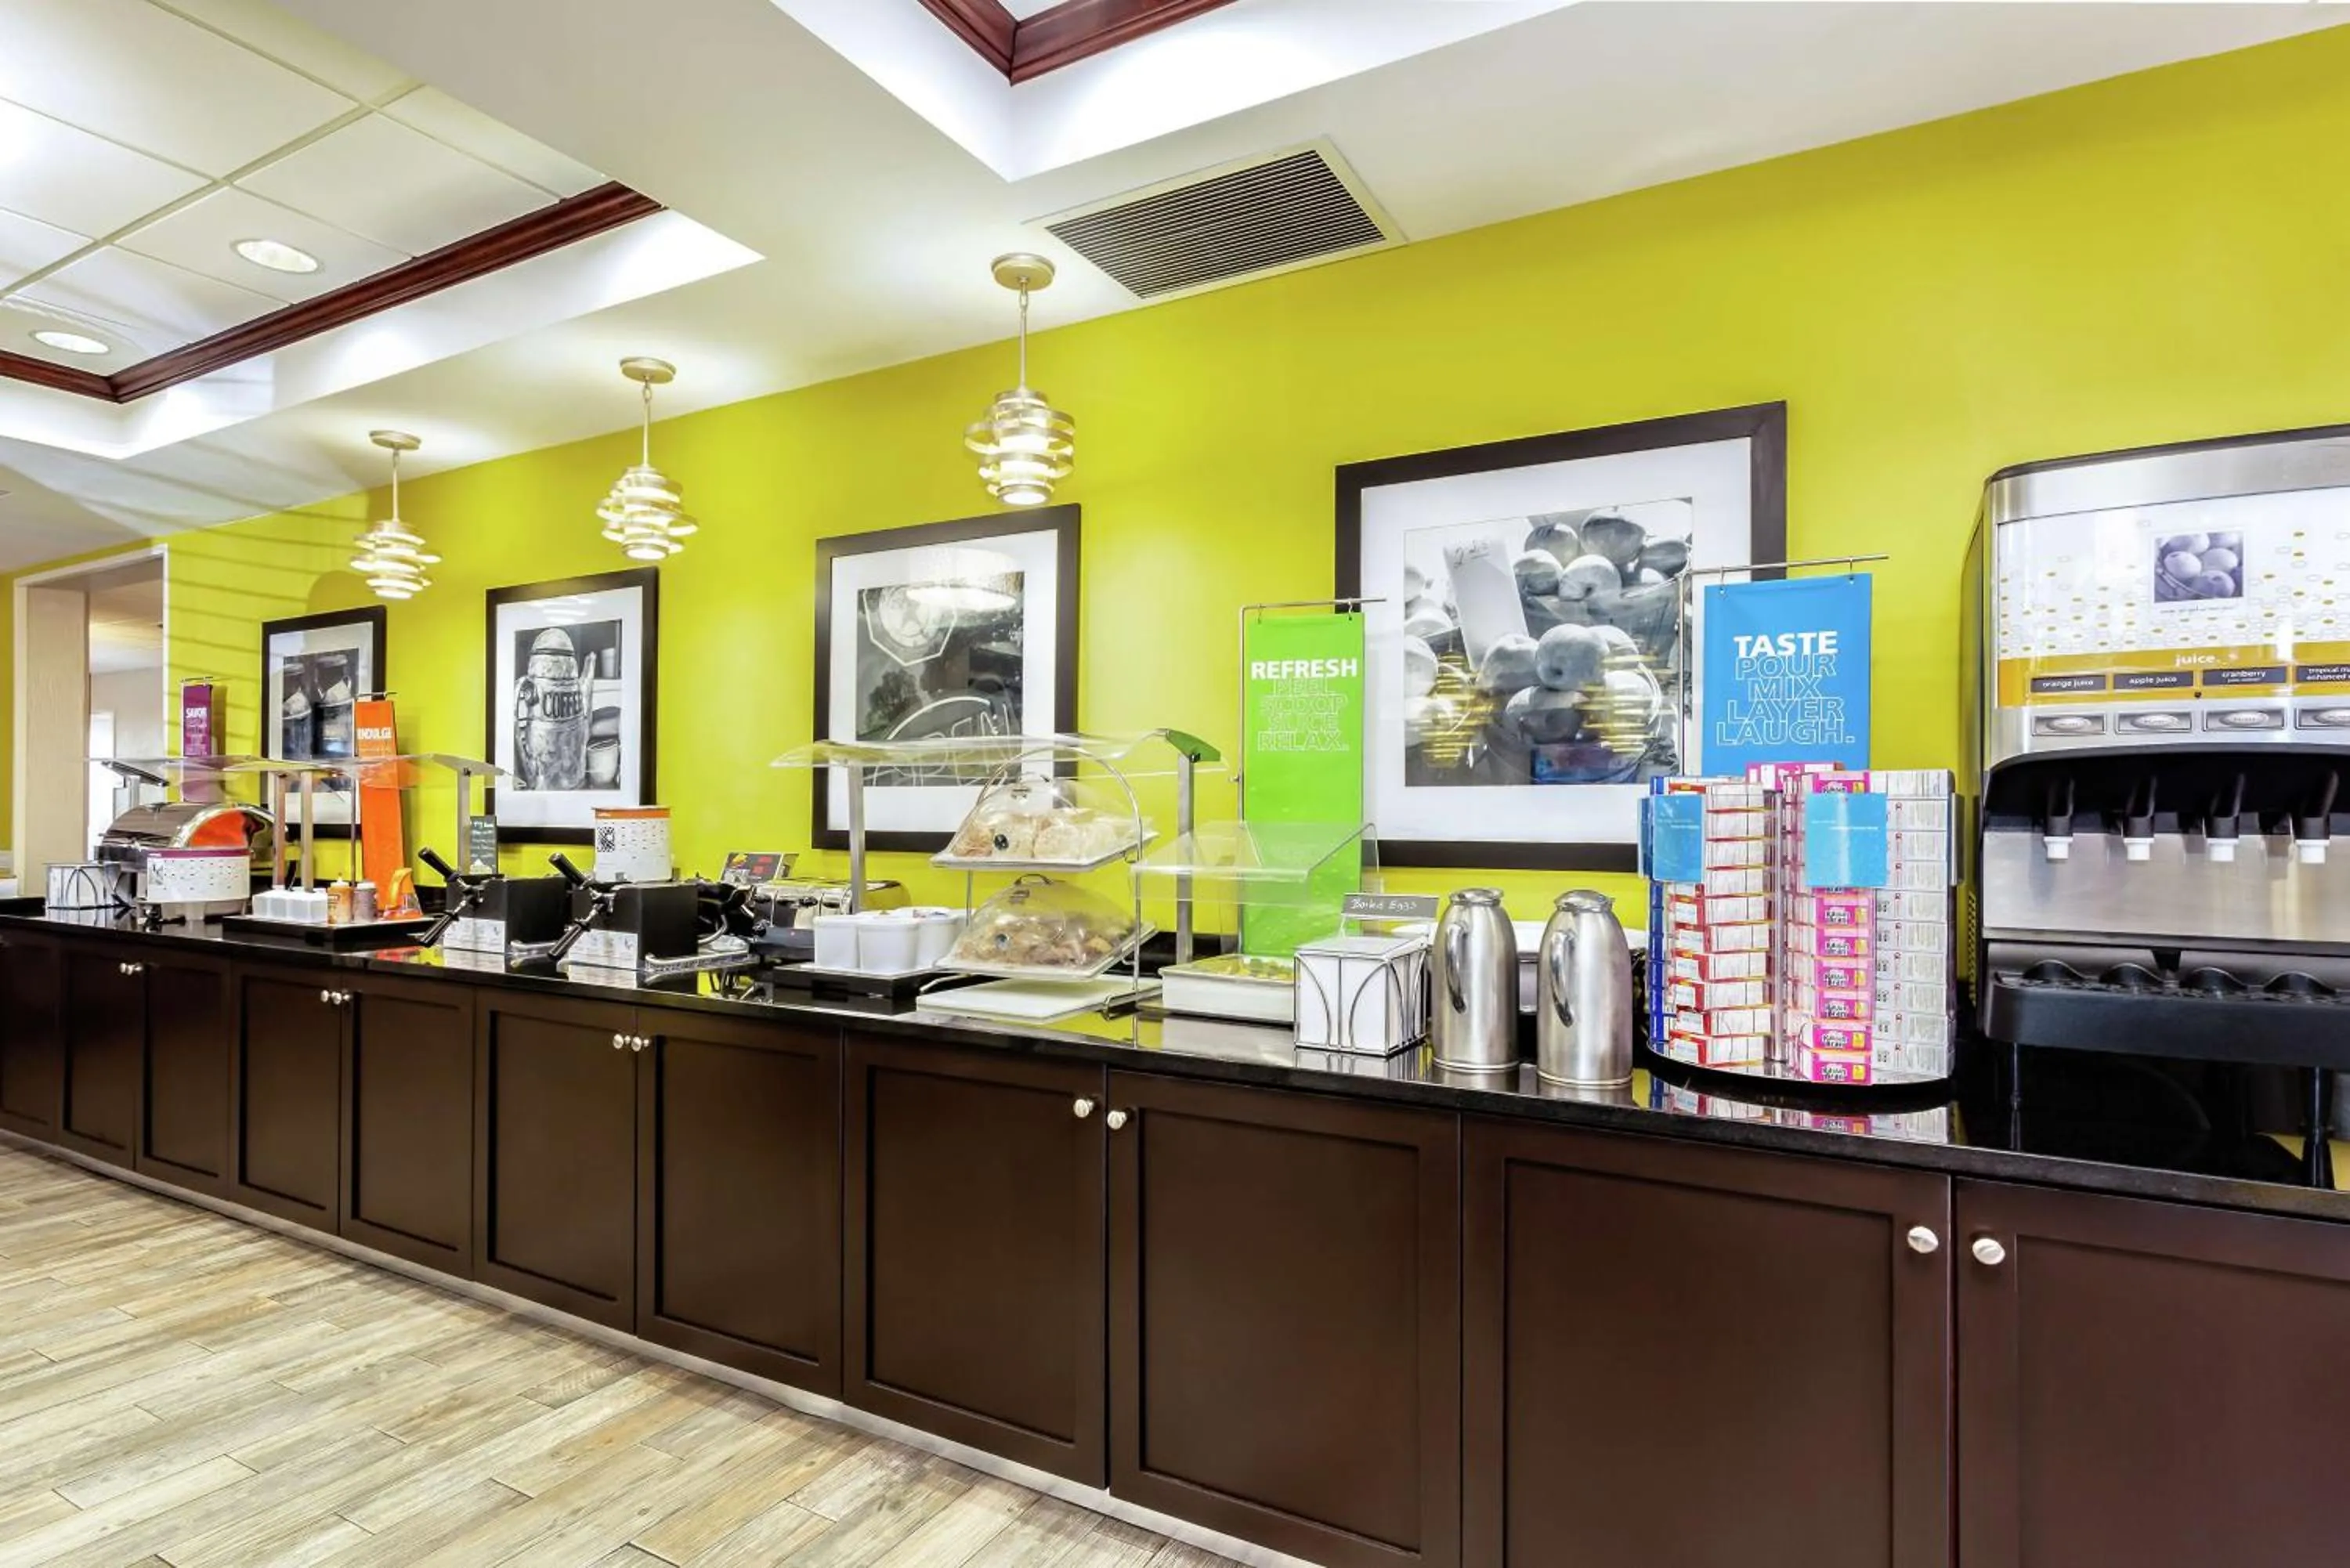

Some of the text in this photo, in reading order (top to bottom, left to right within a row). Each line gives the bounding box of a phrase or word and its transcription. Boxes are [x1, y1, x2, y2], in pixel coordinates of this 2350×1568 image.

[1734, 630, 1838, 659] TASTE
[1251, 658, 1358, 681] REFRESH
[1735, 653, 1837, 681] POUR
[2222, 670, 2266, 678] cranberry
[1748, 676, 1823, 703] MIX
[2042, 680, 2072, 688] orange
[2128, 676, 2154, 685] apple
[542, 691, 583, 717] COFFEE
[1727, 696, 1845, 724] LAYER
[1257, 729, 1350, 752] RELAX.
[1716, 717, 1856, 746] LAUGH.
